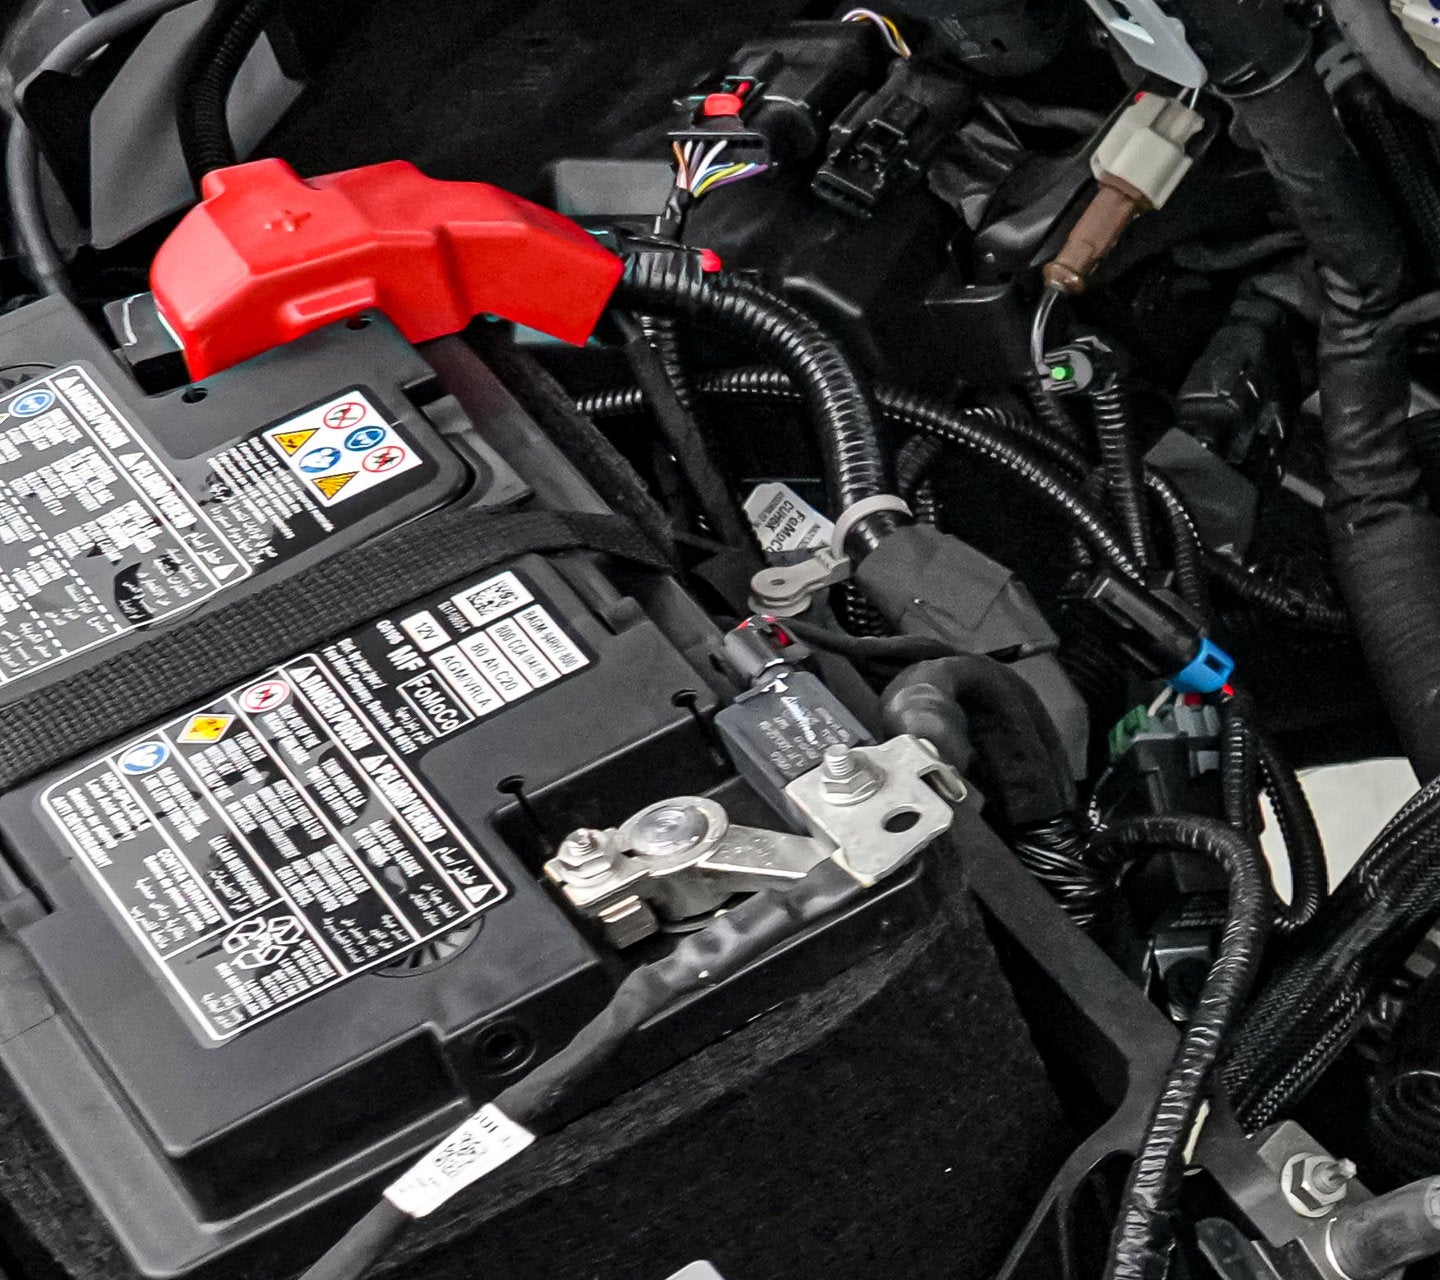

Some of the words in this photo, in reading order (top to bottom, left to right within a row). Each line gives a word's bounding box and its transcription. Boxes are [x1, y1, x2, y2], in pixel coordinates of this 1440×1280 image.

[412, 621, 438, 642] 12V
[506, 638, 530, 657] CCA
[385, 643, 426, 676] MF
[438, 652, 495, 708] AGM/VRLA
[481, 656, 501, 672] Ah
[493, 669, 519, 692] C20
[295, 673, 376, 753] DANGER/POISON
[406, 675, 463, 732] FoMoCo
[367, 762, 450, 844] PELIGRO/VENENO
